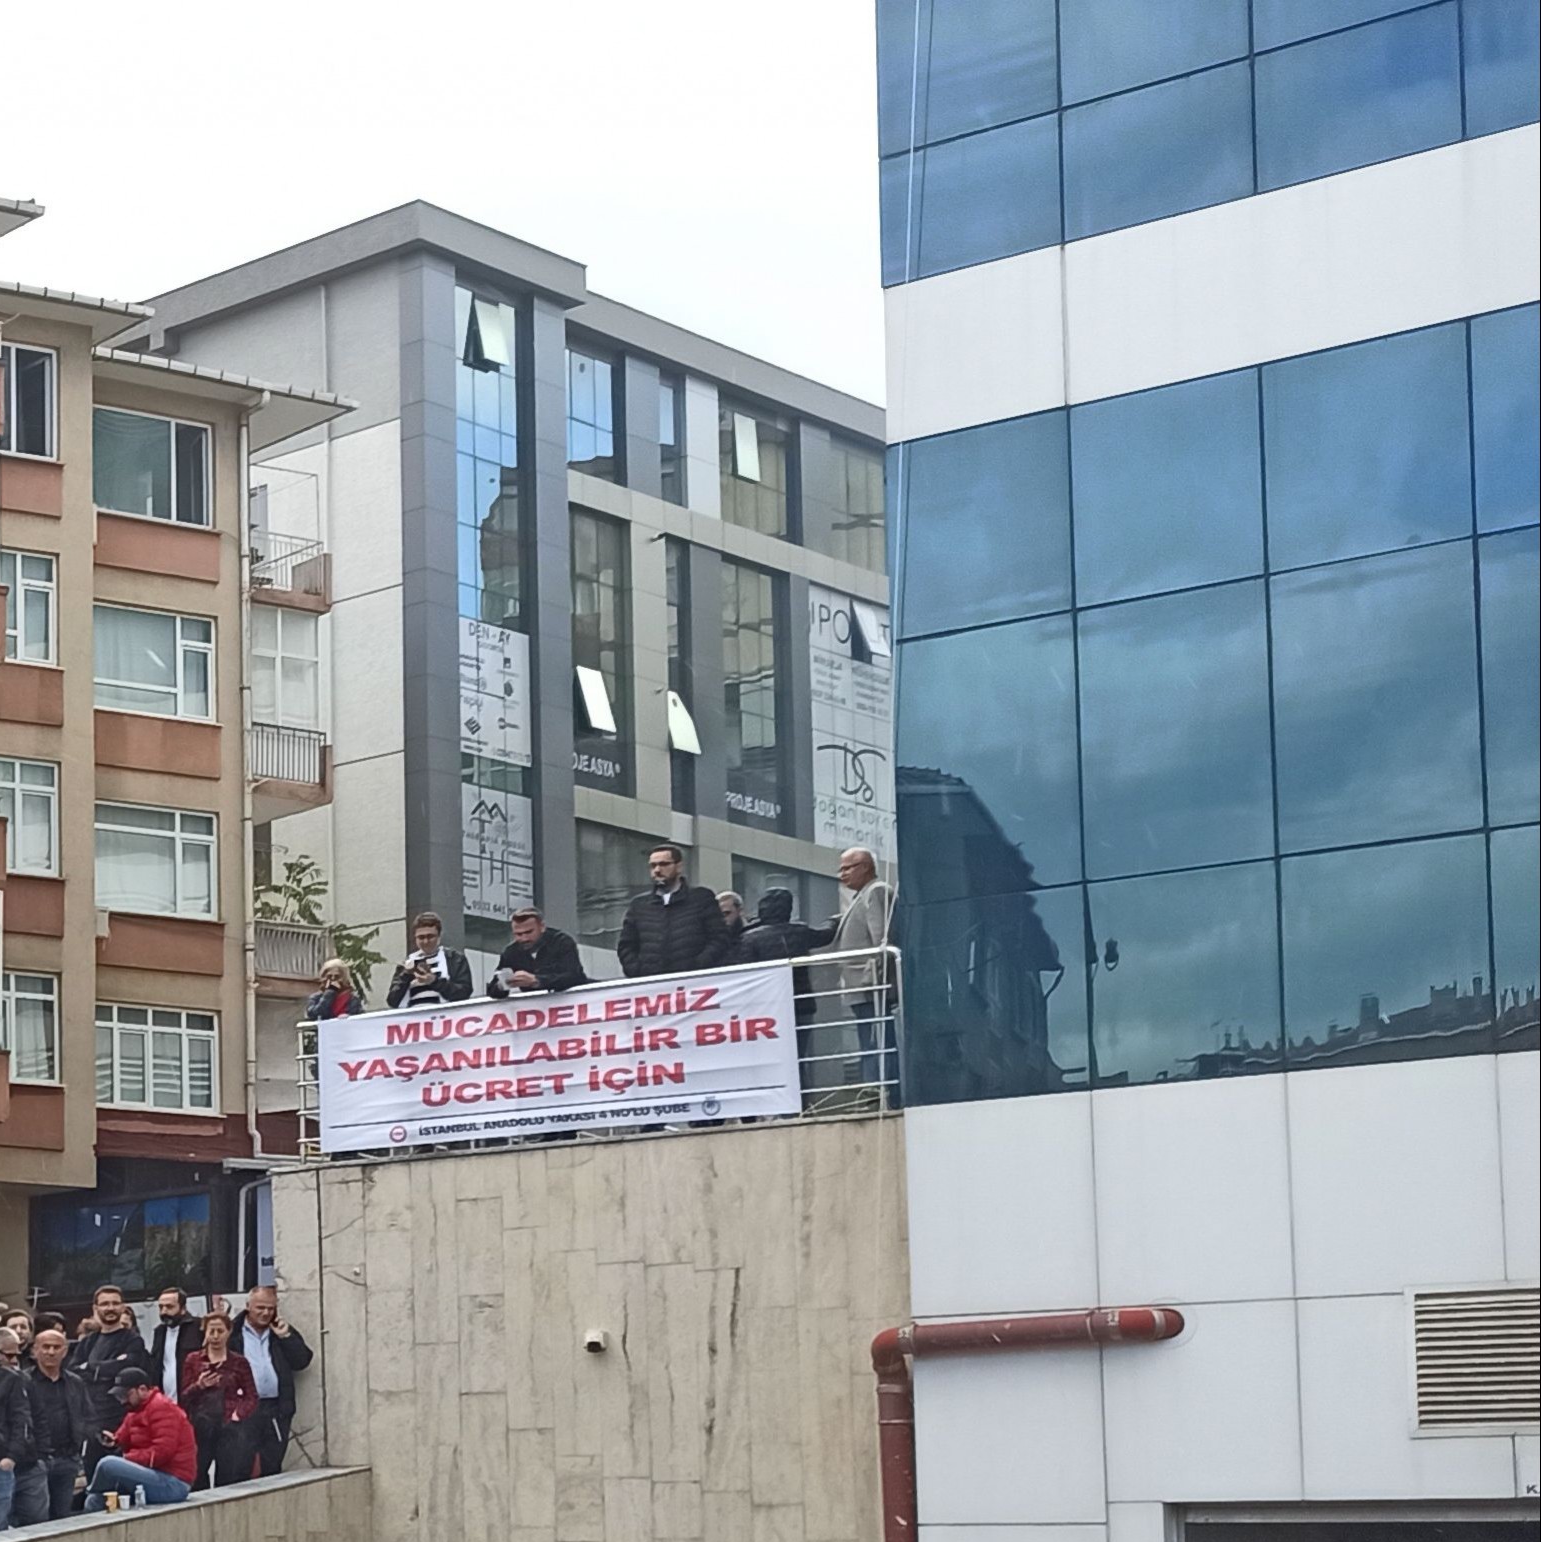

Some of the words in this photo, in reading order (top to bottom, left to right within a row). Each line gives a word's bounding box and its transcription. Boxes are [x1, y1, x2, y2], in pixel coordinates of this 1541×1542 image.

[386, 986, 721, 1045] MÜCADELEMİZ
[338, 1026, 681, 1082] YAŞANILABİLİR
[695, 1015, 780, 1047] BİR
[421, 1072, 573, 1108] ÜCRET
[588, 1059, 686, 1094] İÇİN
[418, 1120, 481, 1136] İSTANBUL
[483, 1115, 545, 1130] ANADOLU
